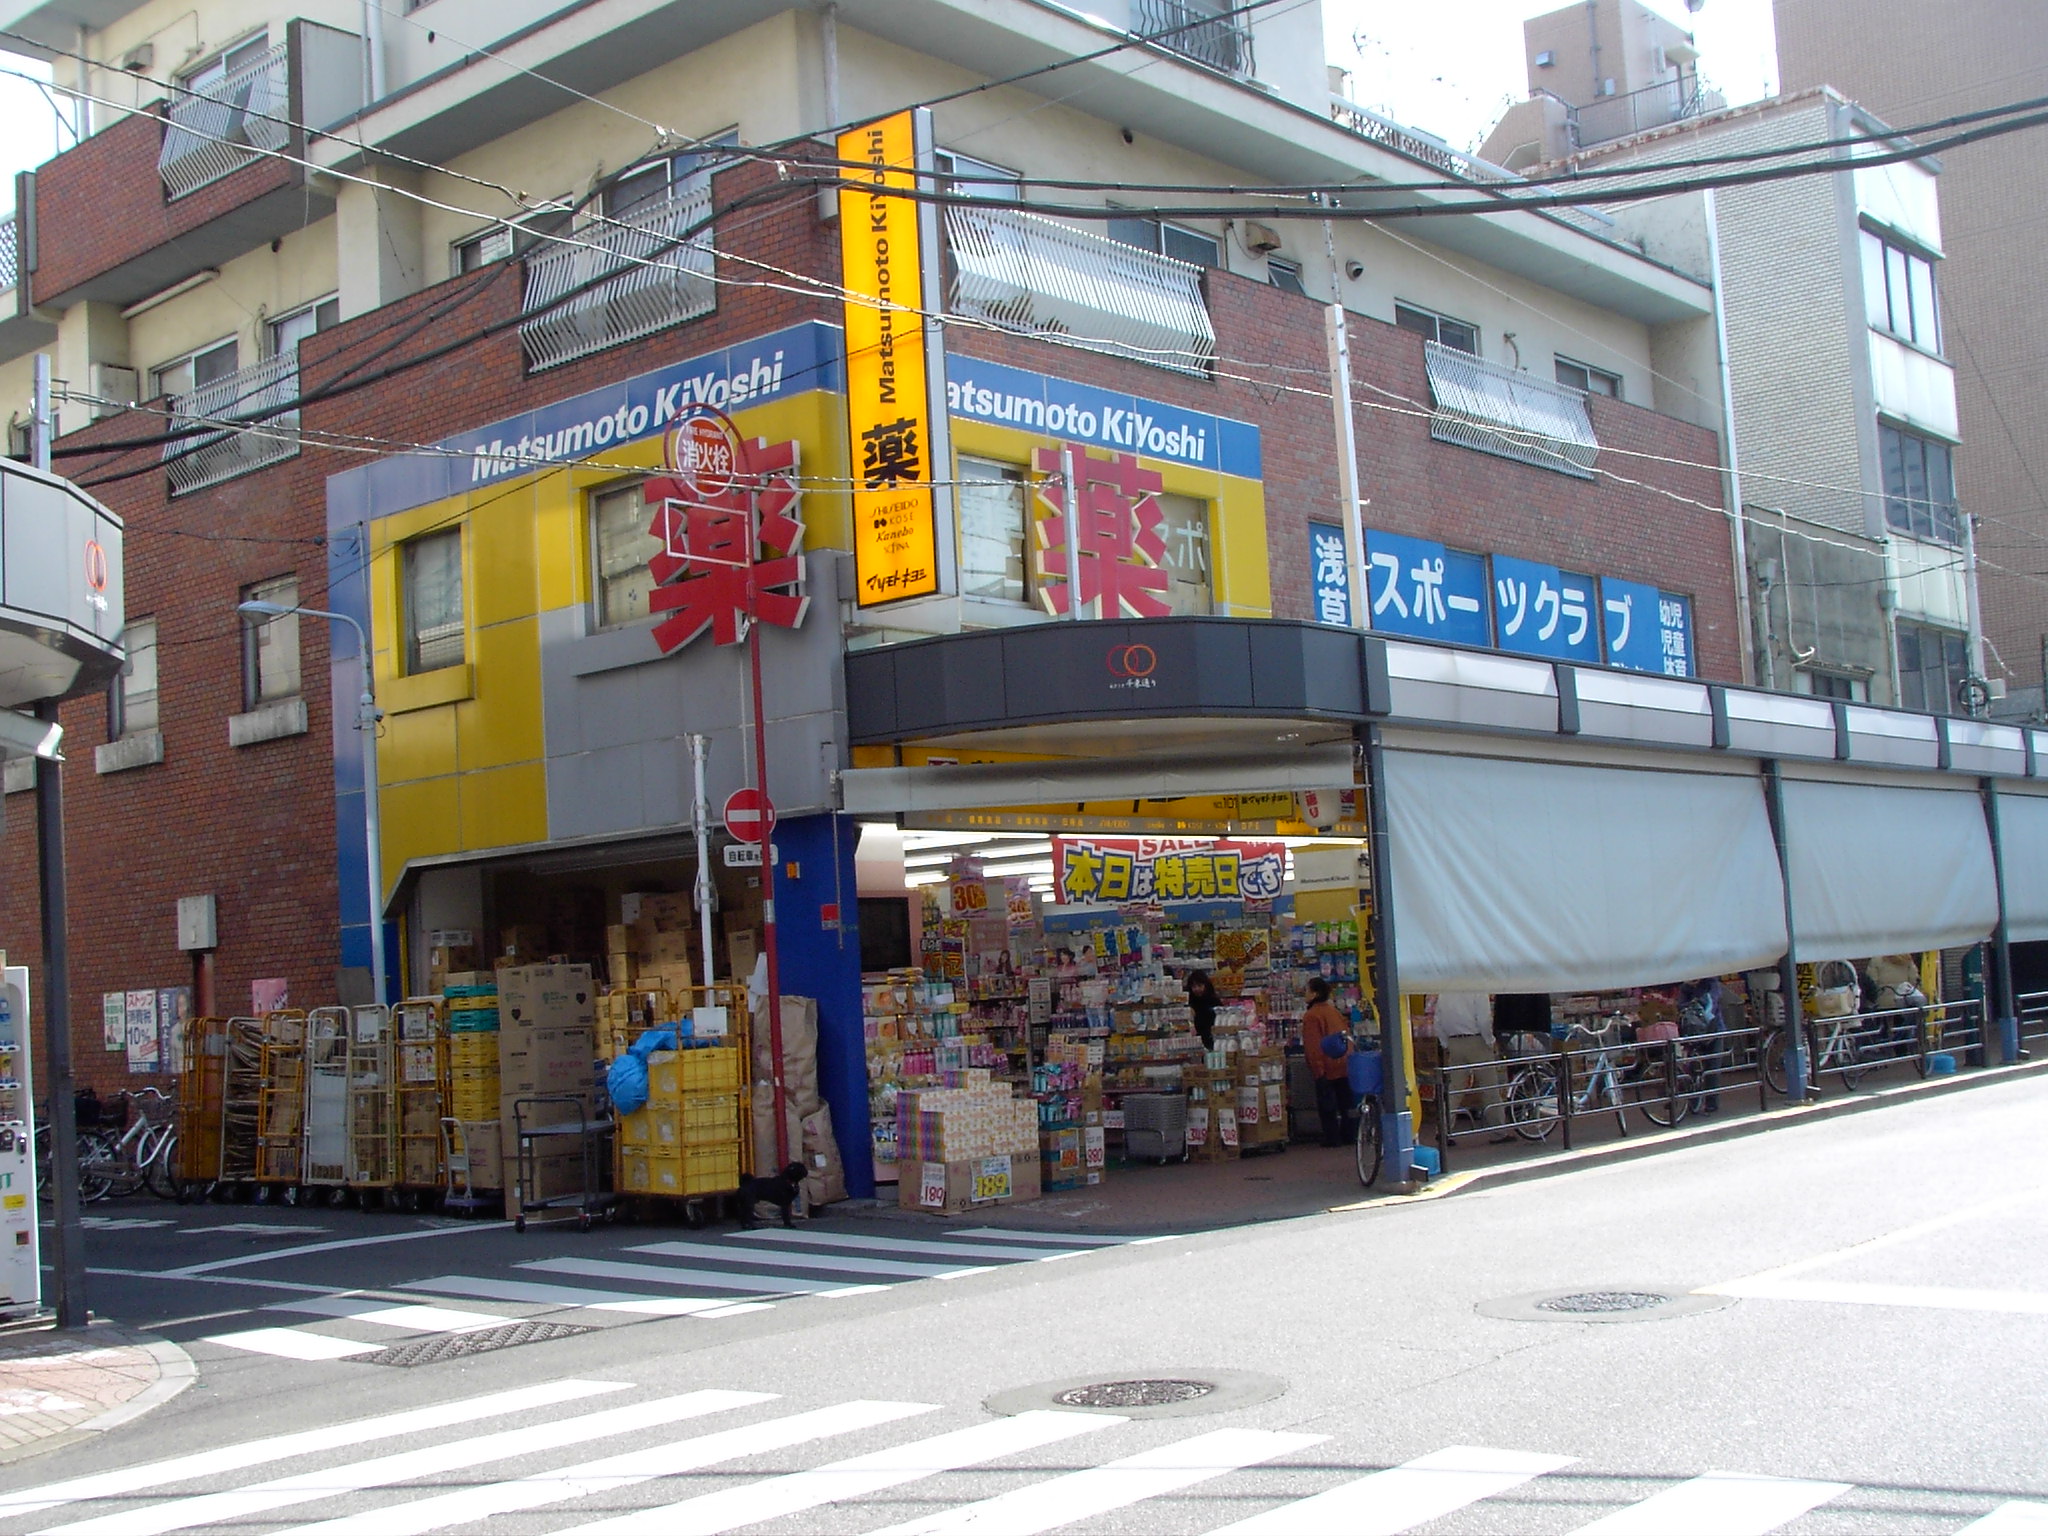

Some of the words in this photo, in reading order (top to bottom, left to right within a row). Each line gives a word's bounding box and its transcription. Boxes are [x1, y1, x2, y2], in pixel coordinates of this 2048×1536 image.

[867, 130, 888, 233] KiYoshi
[876, 238, 896, 403] Matsumoto
[471, 403, 649, 482] Matsumoto
[653, 350, 784, 427] KiYoshi
[861, 416, 922, 491] 薬
[947, 380, 1097, 438] atsumoto
[1101, 406, 1206, 462] KiYoshi
[682, 439, 731, 475] 消火栓
[647, 437, 807, 654] 薬
[871, 499, 919, 517] SHISEIDO
[875, 526, 914, 543] Kanebo
[1033, 443, 1171, 620] 薬
[866, 568, 927, 593] マツモトキヨシ
[1315, 533, 1348, 626] 浅草
[1370, 552, 1633, 653] スポーツクラブ
[1064, 850, 1282, 899] 本日は特売日です
[127, 1026, 151, 1046] 10%
[924, 1185, 944, 1203] 189
[976, 1172, 1008, 1198] 189
